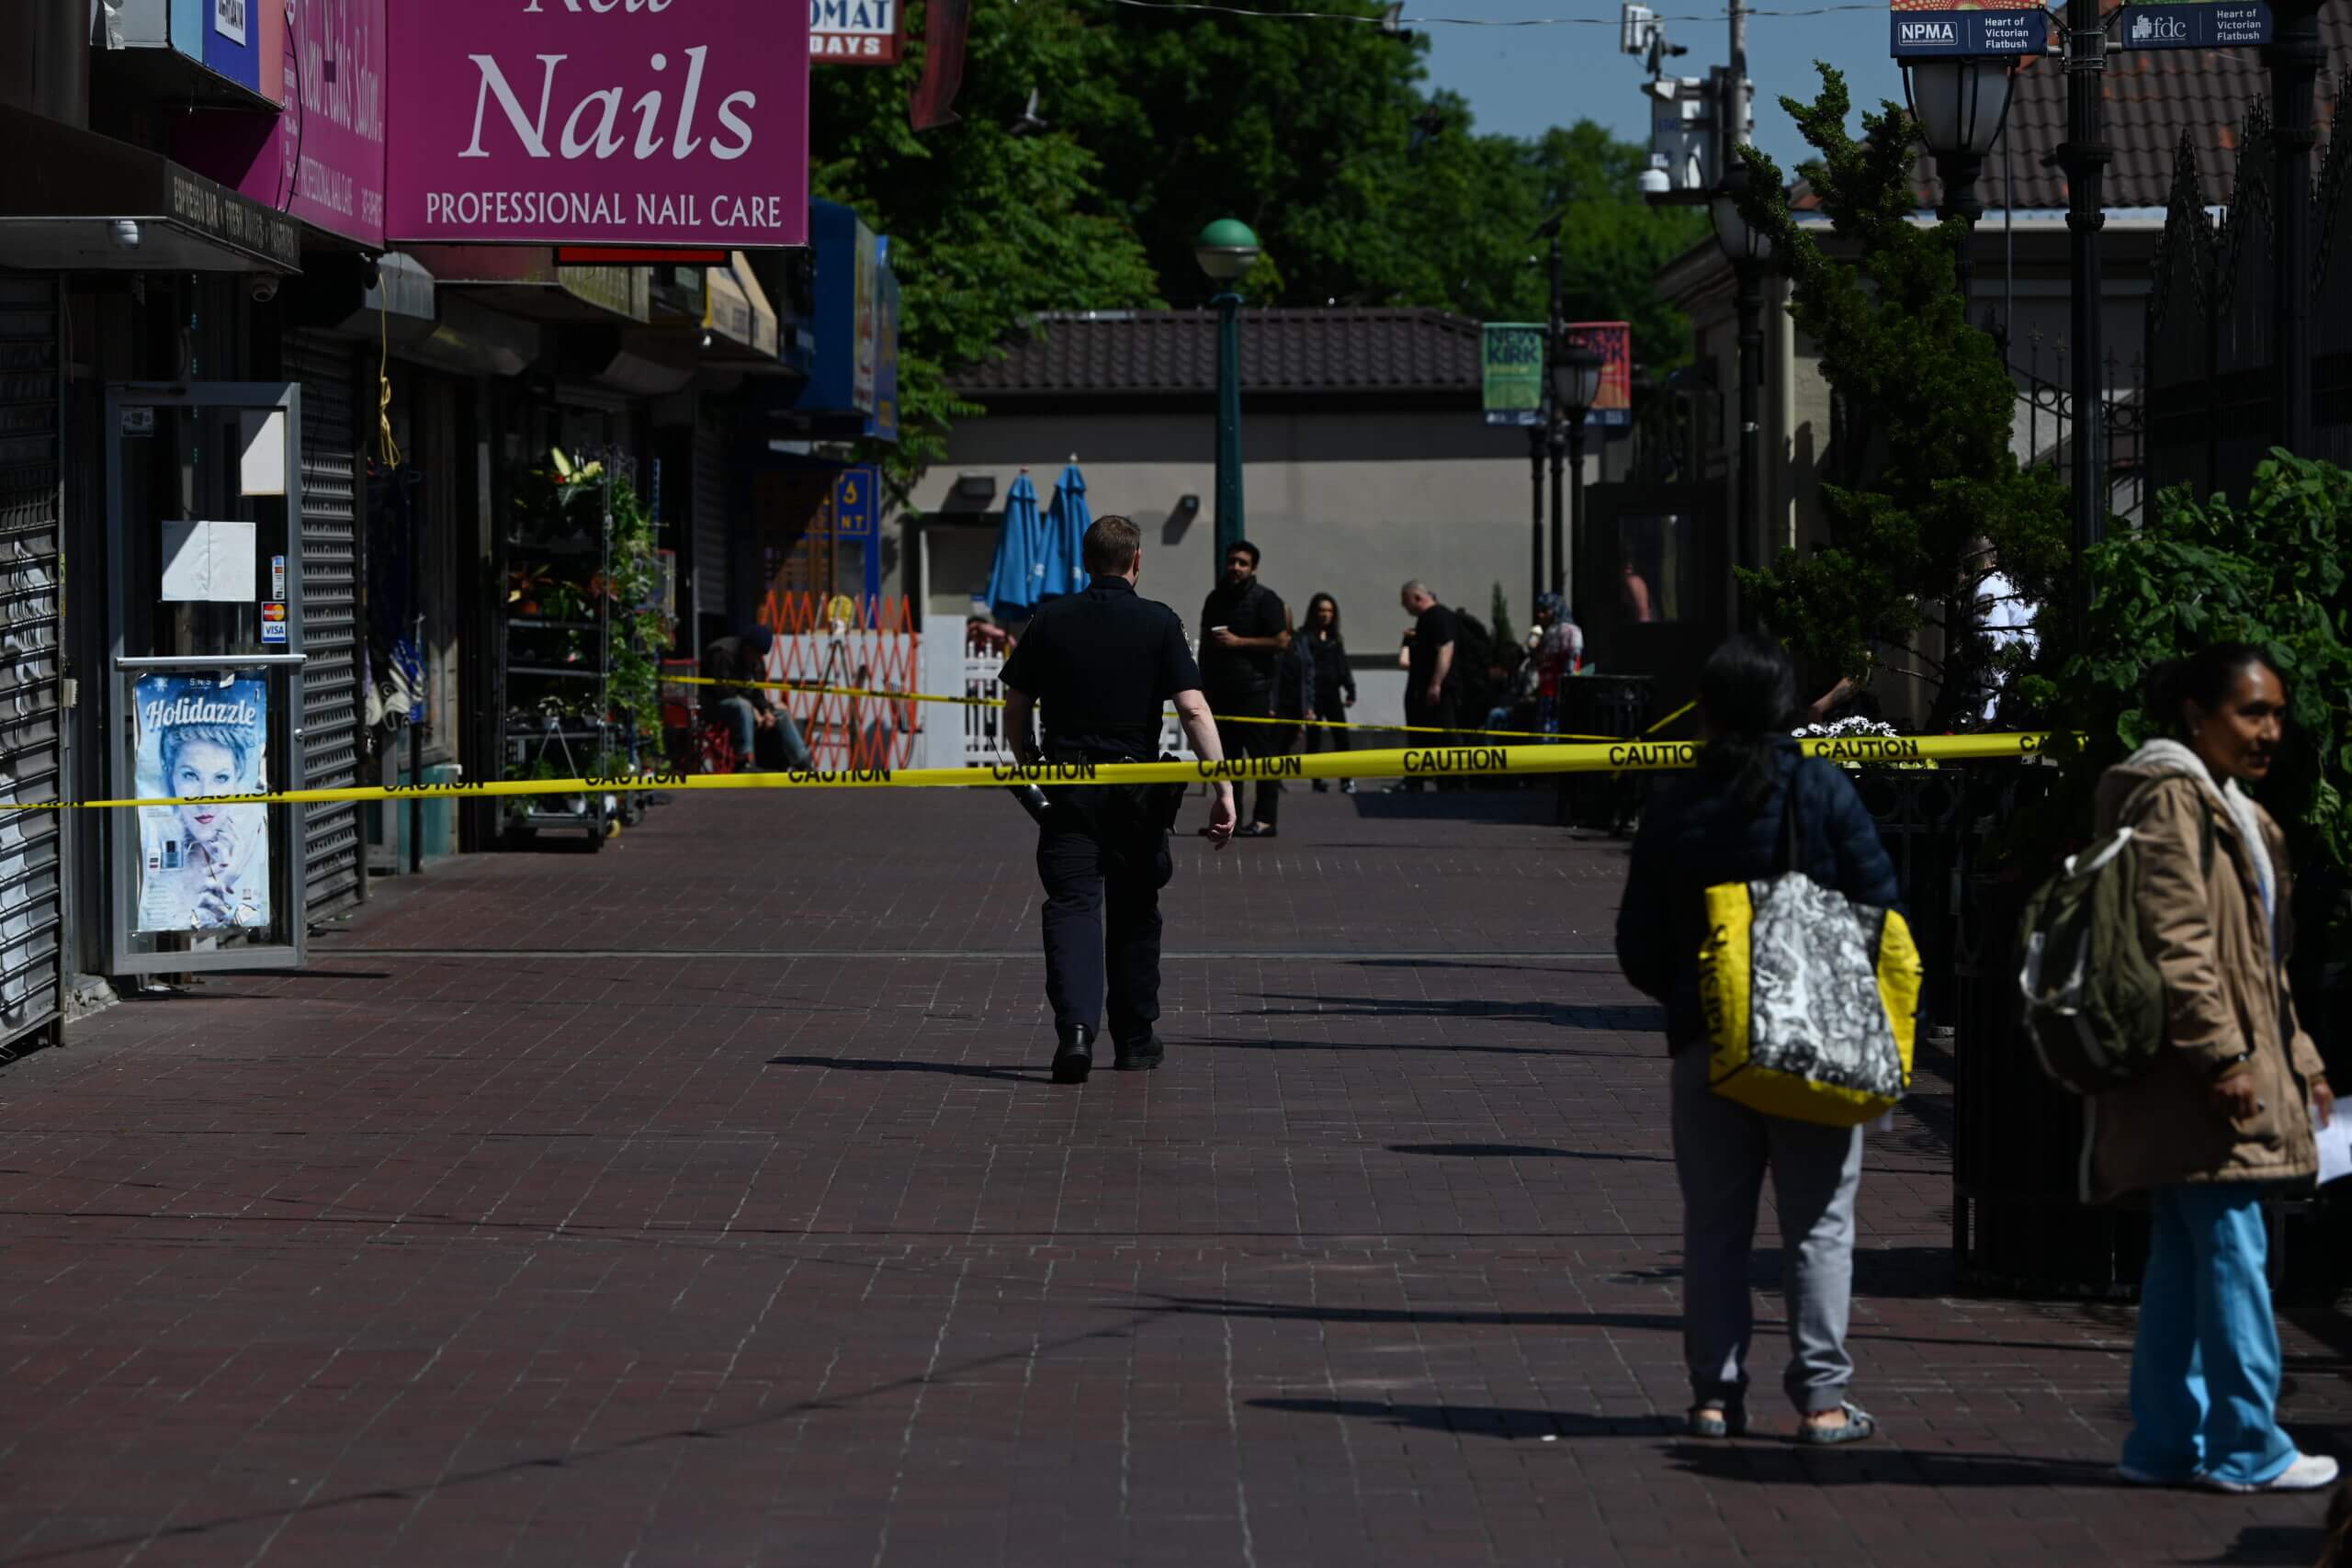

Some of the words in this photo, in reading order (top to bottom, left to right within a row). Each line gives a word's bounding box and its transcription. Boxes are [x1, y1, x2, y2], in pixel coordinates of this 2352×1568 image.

[2217, 10, 2244, 19] Heart
[2246, 8, 2257, 17] of
[1985, 17, 2012, 27] Heart
[2014, 17, 2025, 27] of
[2153, 17, 2188, 39] fdc
[2217, 20, 2261, 30] Victorian
[1902, 24, 1954, 39] NPMA
[1985, 28, 2029, 38] Victorian
[2217, 31, 2260, 41] Flatbush
[809, 36, 881, 55] DAYS
[1985, 39, 2028, 49] Flatbush
[458, 44, 757, 161] Nails
[426, 191, 626, 225] PROFESSIONAL
[635, 193, 701, 226] NAIL
[710, 195, 781, 228] CARE
[1488, 346, 1539, 364] KIRK
[266, 626, 284, 635] VISA
[146, 695, 256, 730] Holidazzle
[992, 763, 1095, 781] CAUTION
[1198, 756, 1301, 777] CAUTION
[1403, 749, 1507, 773] CAUTION
[1610, 745, 1695, 765] CAUTIO
[1815, 739, 1918, 758] CAUTION
